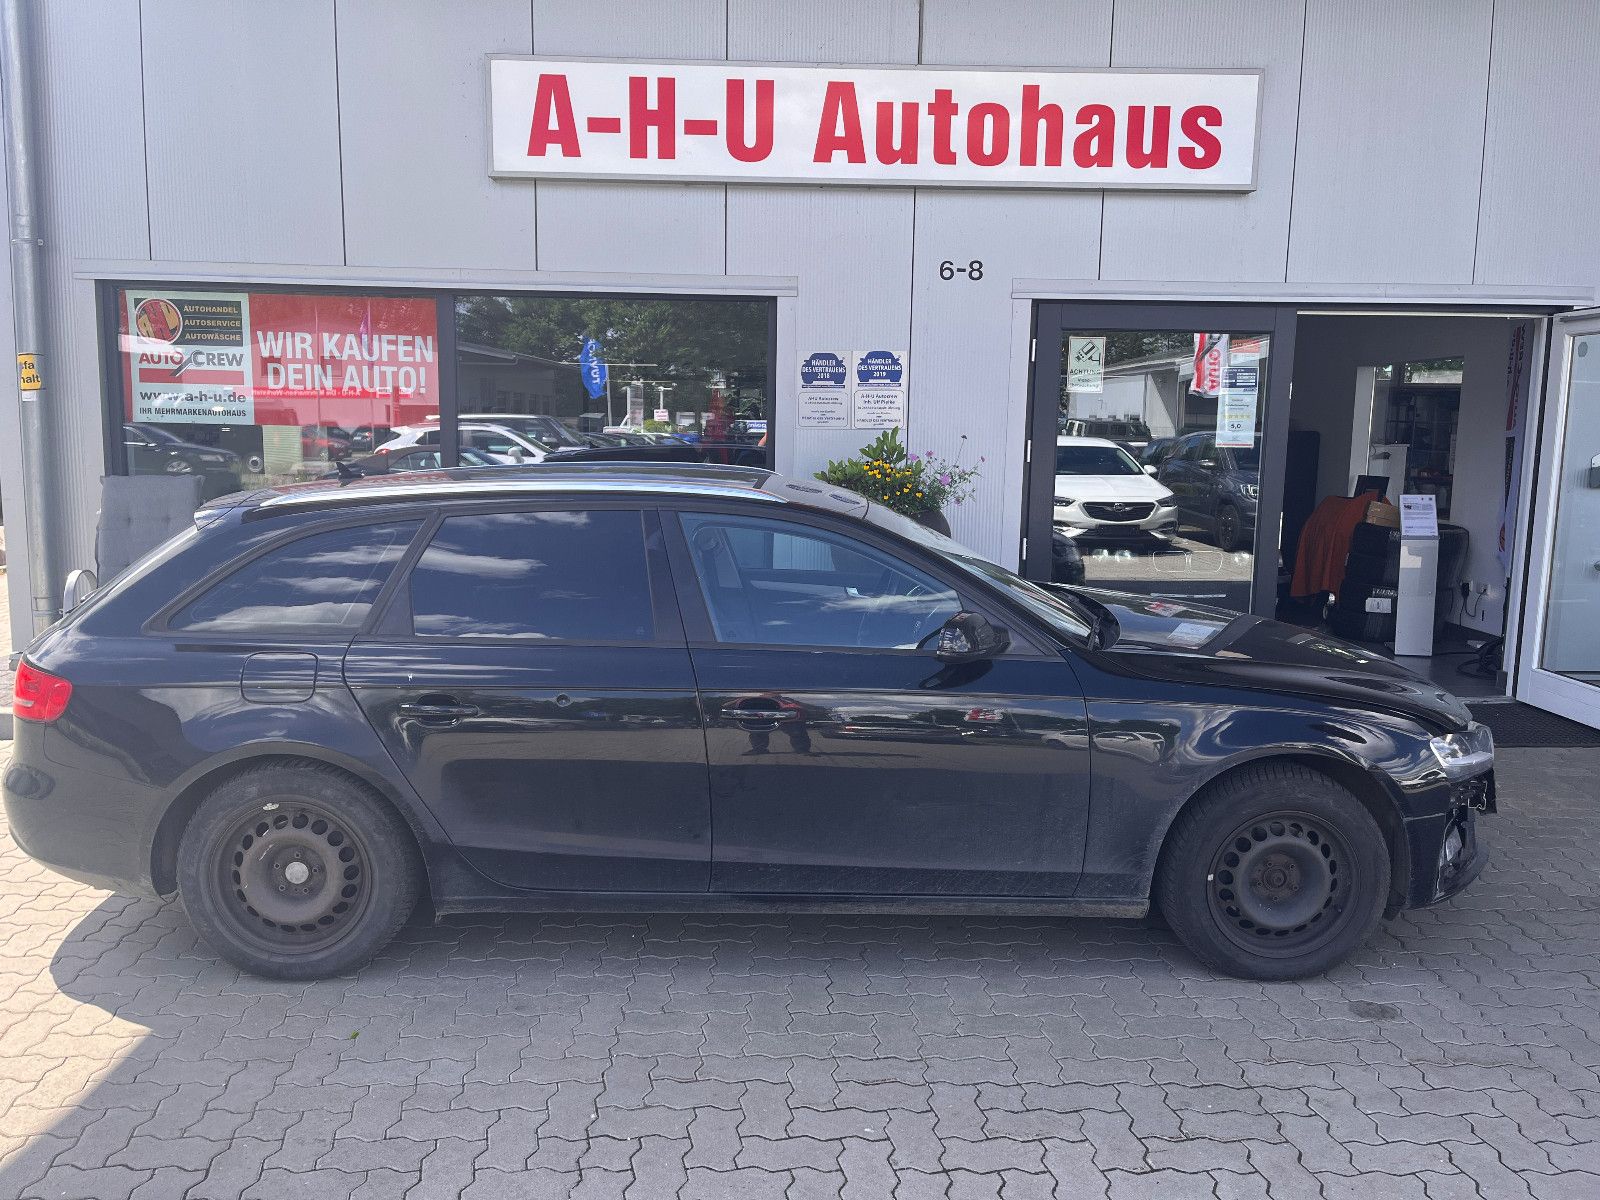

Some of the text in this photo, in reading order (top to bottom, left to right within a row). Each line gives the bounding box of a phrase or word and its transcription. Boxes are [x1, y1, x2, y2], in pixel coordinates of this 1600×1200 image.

[527, 74, 1223, 170] A-H-U Autohaus
[940, 260, 983, 280] 6-8
[183, 305, 238, 314] AUTOHANDEL
[184, 319, 241, 327] AUTOSERVICE
[185, 332, 241, 341] AUTOWÄSCHE
[257, 331, 433, 363] WIR KAUFEN
[139, 351, 244, 367] AUTO CREW
[267, 363, 426, 394] DEIN AUTO!
[140, 407, 247, 417] IHR MEHRMARKENAUTOHAUS
